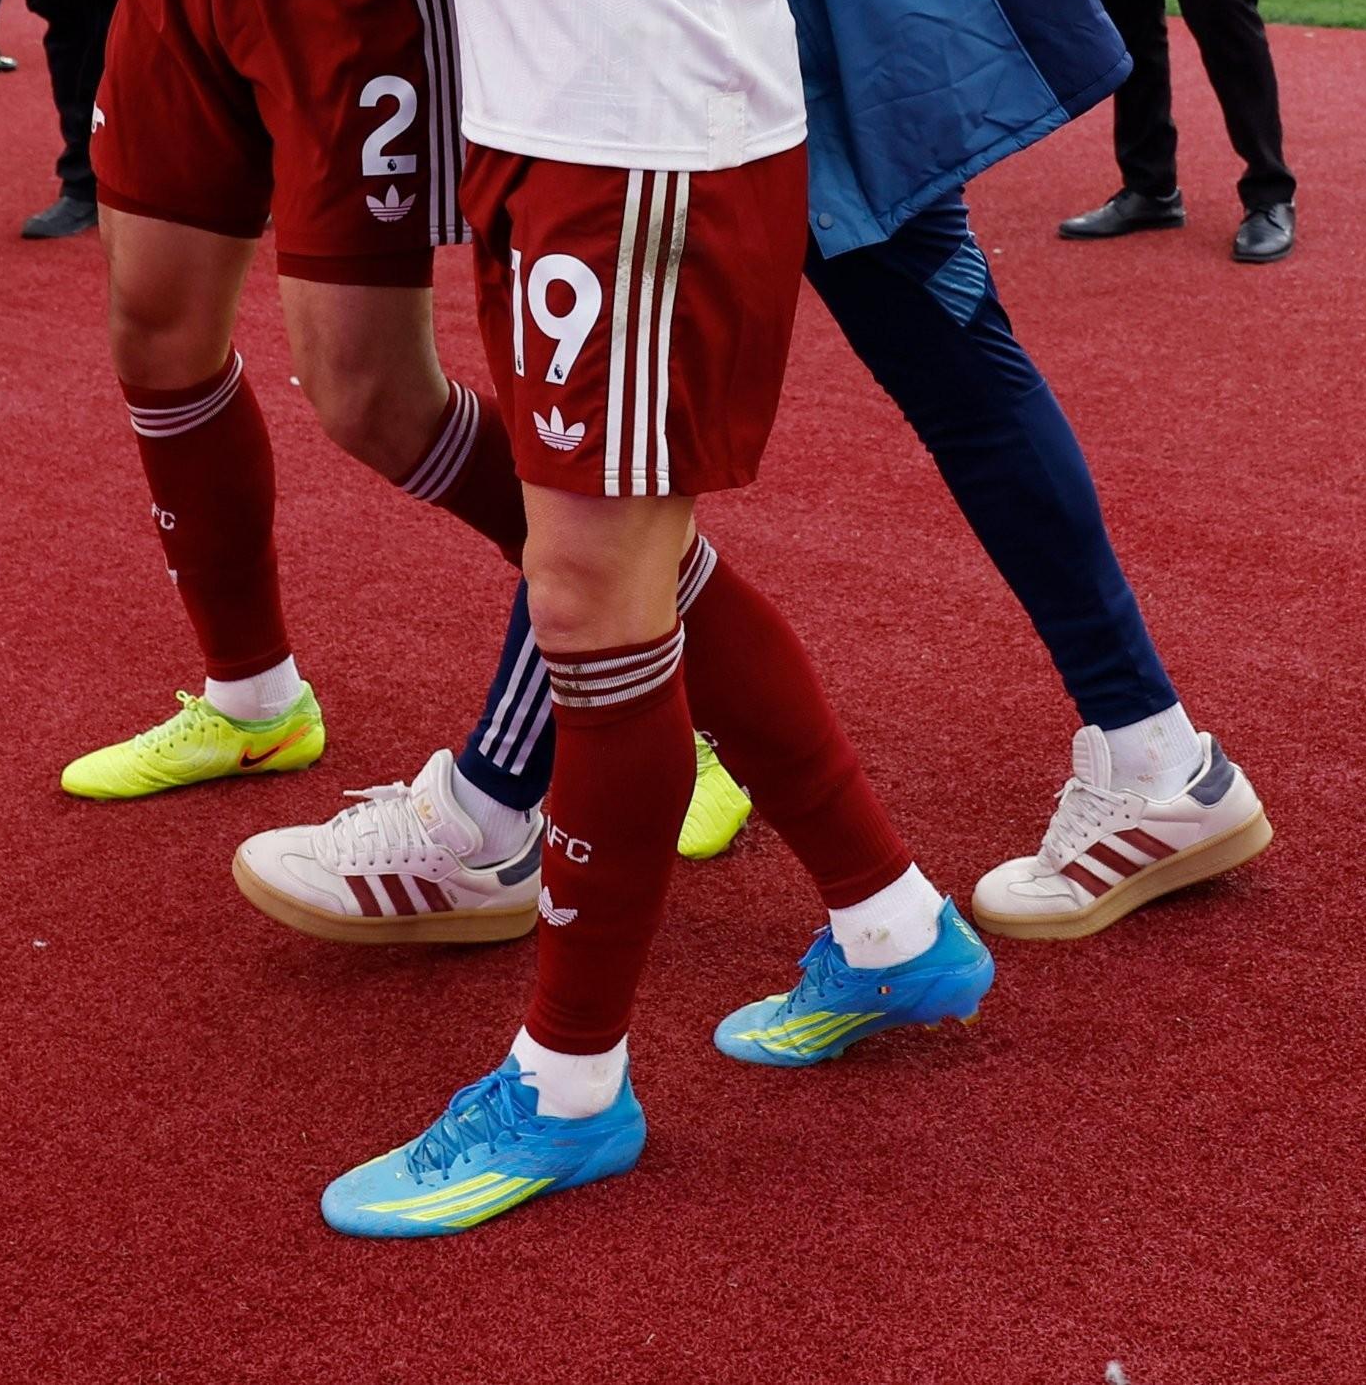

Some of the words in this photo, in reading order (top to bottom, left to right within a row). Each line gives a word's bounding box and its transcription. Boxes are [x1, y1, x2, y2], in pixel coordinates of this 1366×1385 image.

[359, 75, 418, 176] 2
[511, 248, 603, 385] 19
[151, 502, 176, 530] FC
